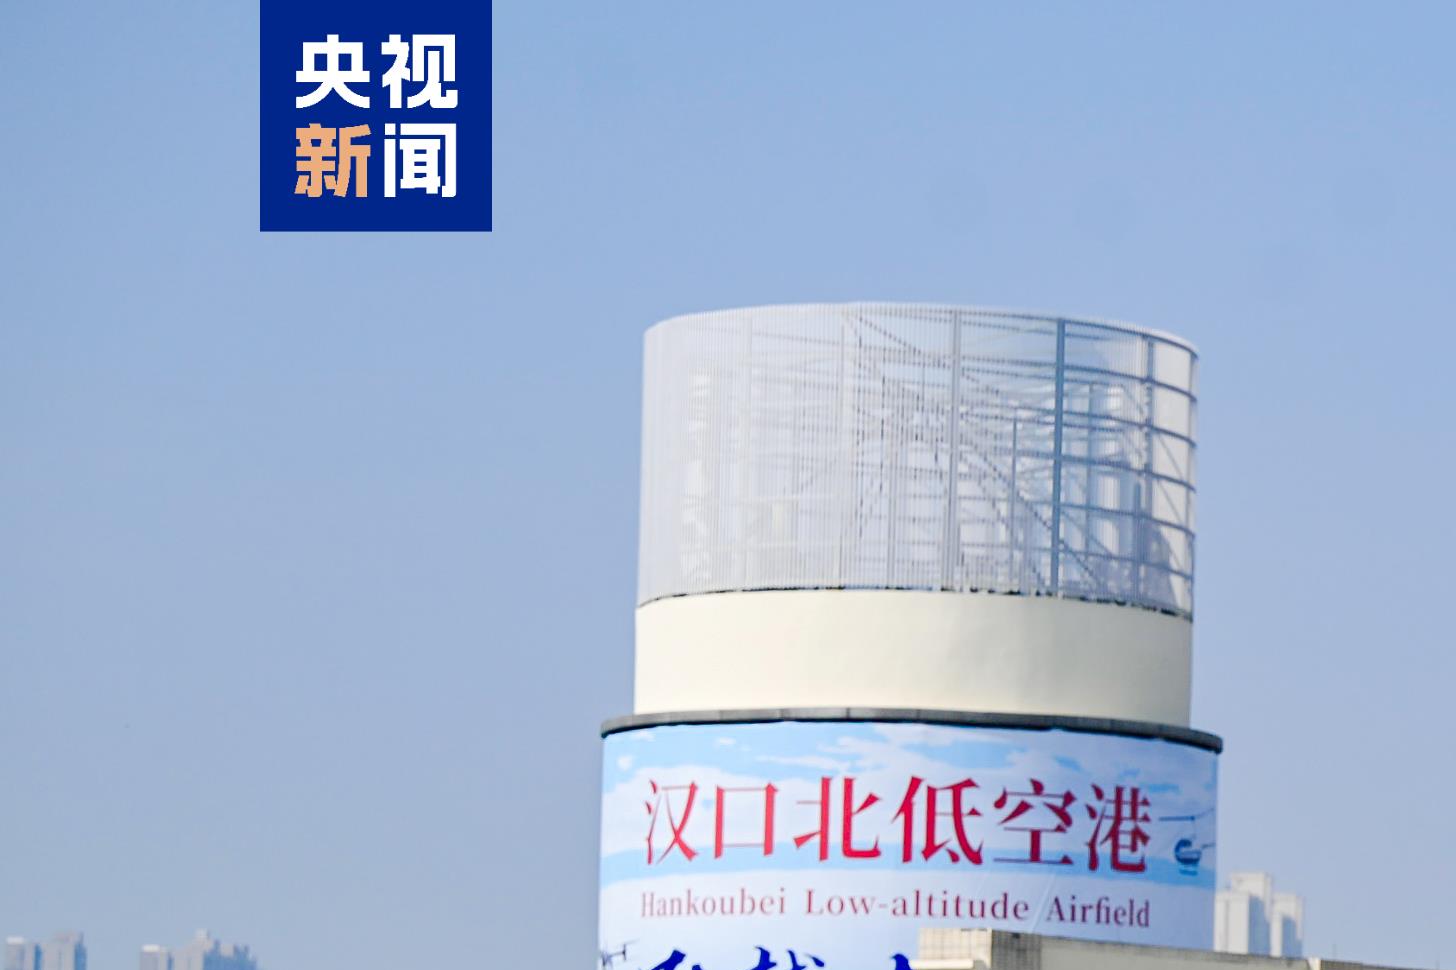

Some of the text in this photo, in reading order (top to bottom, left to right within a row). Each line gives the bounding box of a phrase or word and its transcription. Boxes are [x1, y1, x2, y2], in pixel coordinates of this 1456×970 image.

[643, 775, 1152, 874] 汉口北低空港
[640, 886, 1151, 928] Hankoubei Low-altitude Airfield
